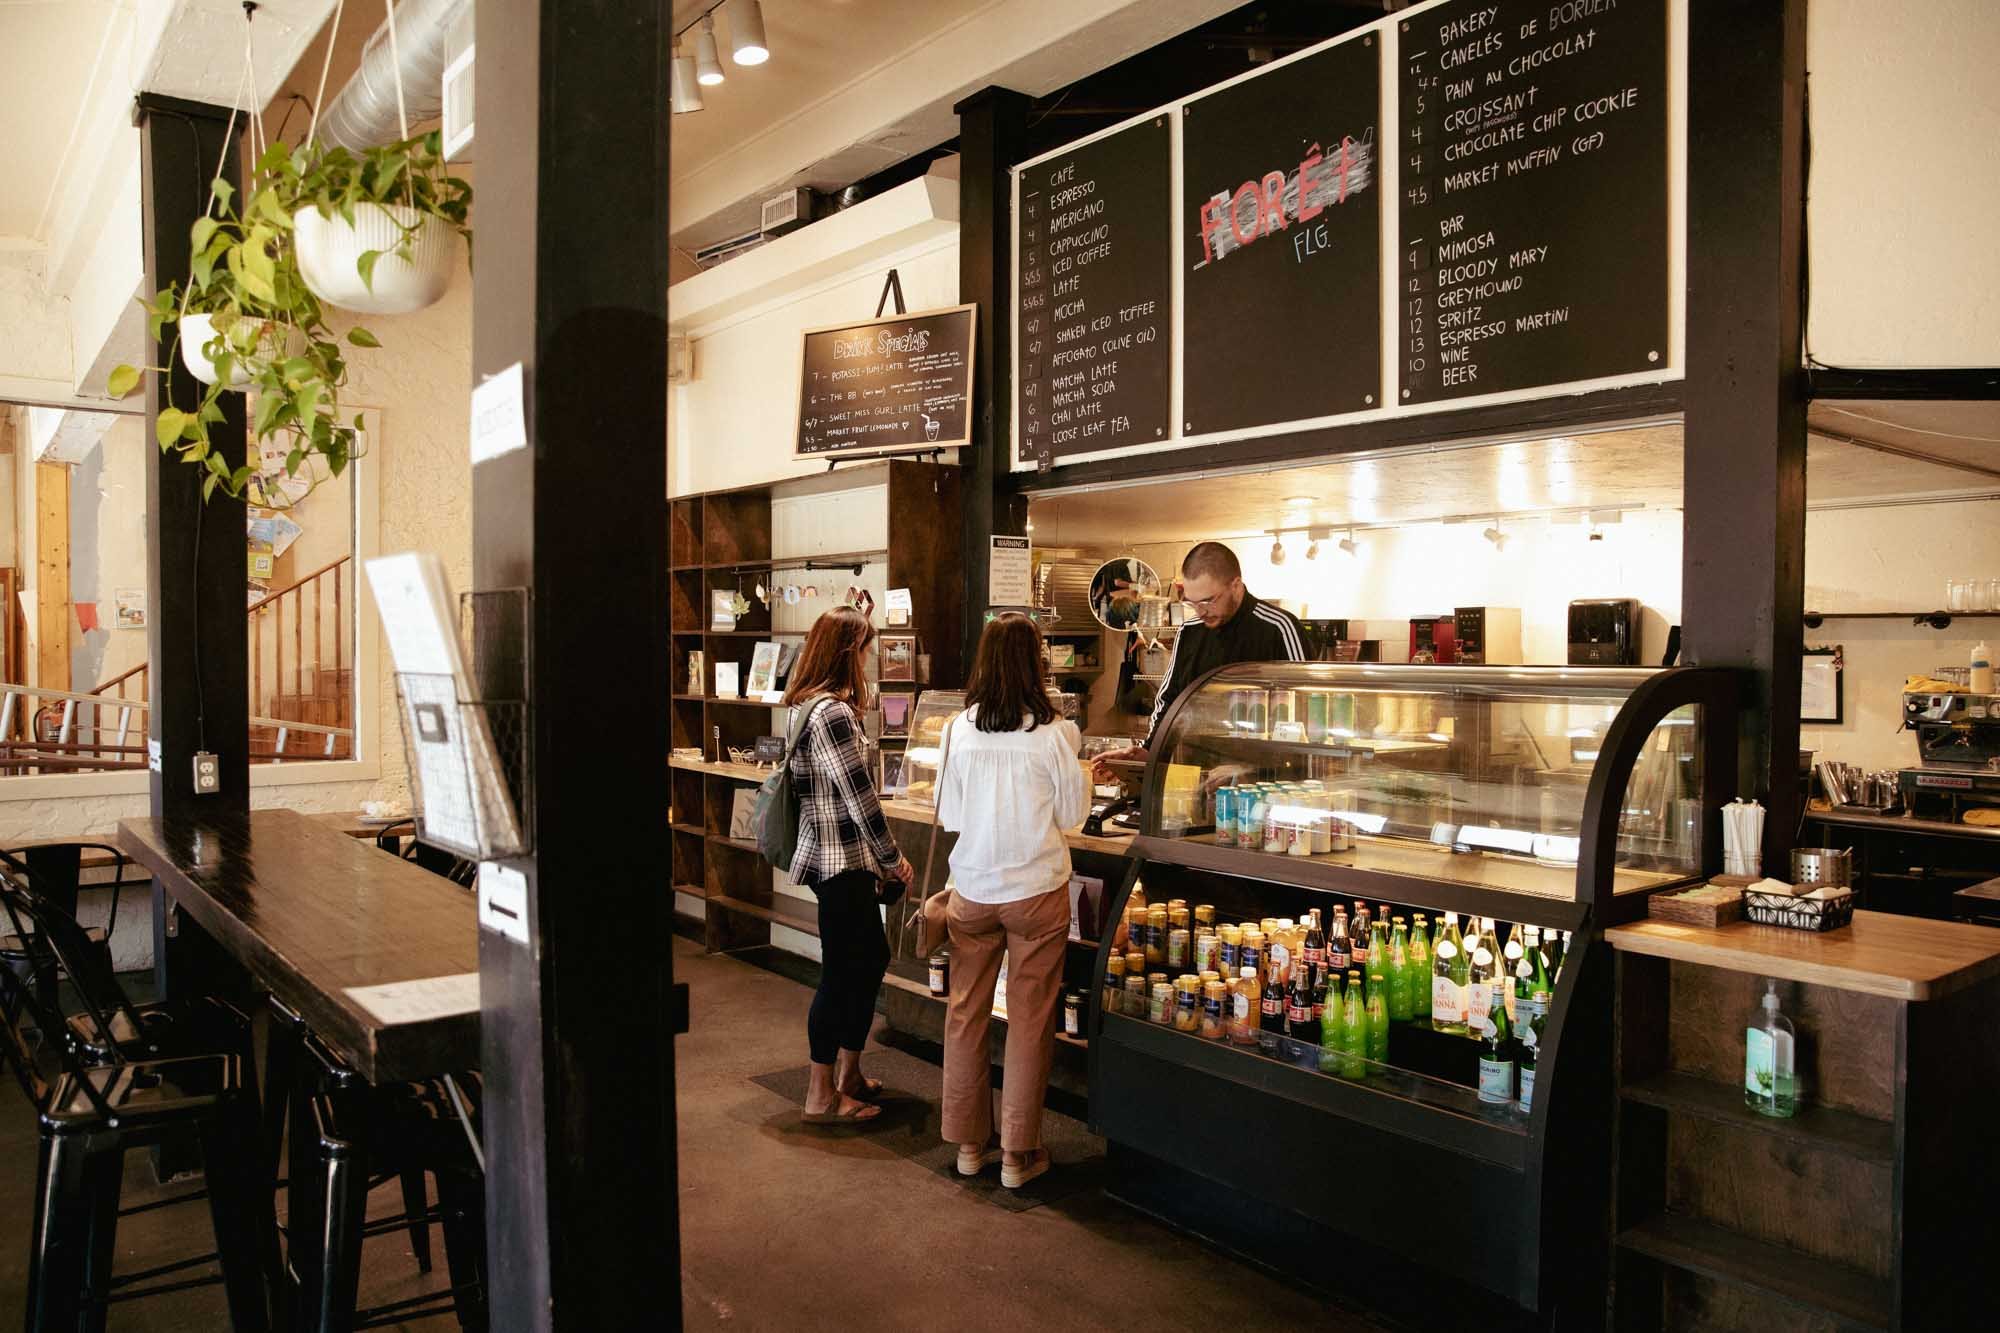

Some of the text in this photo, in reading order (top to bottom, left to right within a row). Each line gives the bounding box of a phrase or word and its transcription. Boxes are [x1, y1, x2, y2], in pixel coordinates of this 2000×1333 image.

[1440, 7, 1498, 46] BAKERY
[1440, 32, 1503, 70] CANELÉS
[1520, 19, 1537, 39] DE
[1417, 28, 1596, 114] 5 PAIN AU CHOCOLAT
[1411, 127, 1422, 144] 4
[1444, 85, 1538, 132] CROISSANT
[1411, 154, 1422, 174] 4
[1444, 122, 1525, 161] CHOCOLATE
[1532, 106, 1567, 132] CHIP
[1574, 88, 1639, 123] COOKIE
[1051, 162, 1074, 186] CAFÉ
[1444, 161, 1500, 194] MARKET
[1507, 145, 1562, 177] MUFFIN
[1572, 131, 1605, 155] (GF)
[1028, 180, 1096, 218] 4 ESPRESSO
[1028, 200, 1105, 242] 4 AMERICANO
[1440, 215, 1464, 238] BAR
[1029, 224, 1109, 265] 5 CAPPUCCINO
[1053, 256, 1072, 276] ICED
[1077, 242, 1112, 265] COFFEE
[1409, 231, 1495, 270] 9 MIMOSA
[1053, 275, 1080, 297] LATTE
[1409, 245, 1548, 293] 12 BLOODY MARY
[1054, 298, 1085, 323] MOCHA
[1409, 276, 1523, 316] 12 GREYHOUND
[1056, 324, 1086, 344] SHAKEN
[1091, 316, 1111, 333] ICED
[1119, 301, 1156, 324] TOFFEE
[1410, 306, 1482, 334] 12 SPRITZ
[1411, 307, 1569, 353] 13 ESPRESSO MARTINI
[1053, 346, 1097, 368] AFFOGATO
[1102, 334, 1132, 355] (OLIVE
[1136, 326, 1156, 343] OIL)
[1409, 346, 1470, 373] 10 WINE
[1053, 371, 1085, 391] MATCHA
[1091, 361, 1118, 381] LATTE
[1053, 387, 1086, 408] MATCHA
[1091, 380, 1116, 397] SODA
[1443, 364, 1478, 387] BEER
[829, 410, 851, 423] SWEET
[1026, 416, 1130, 449] 4 LOOSE LEAF TEA
[1051, 409, 1071, 425] CHAI
[1076, 402, 1102, 418] LATTE
[996, 539, 1026, 548] WARNING
